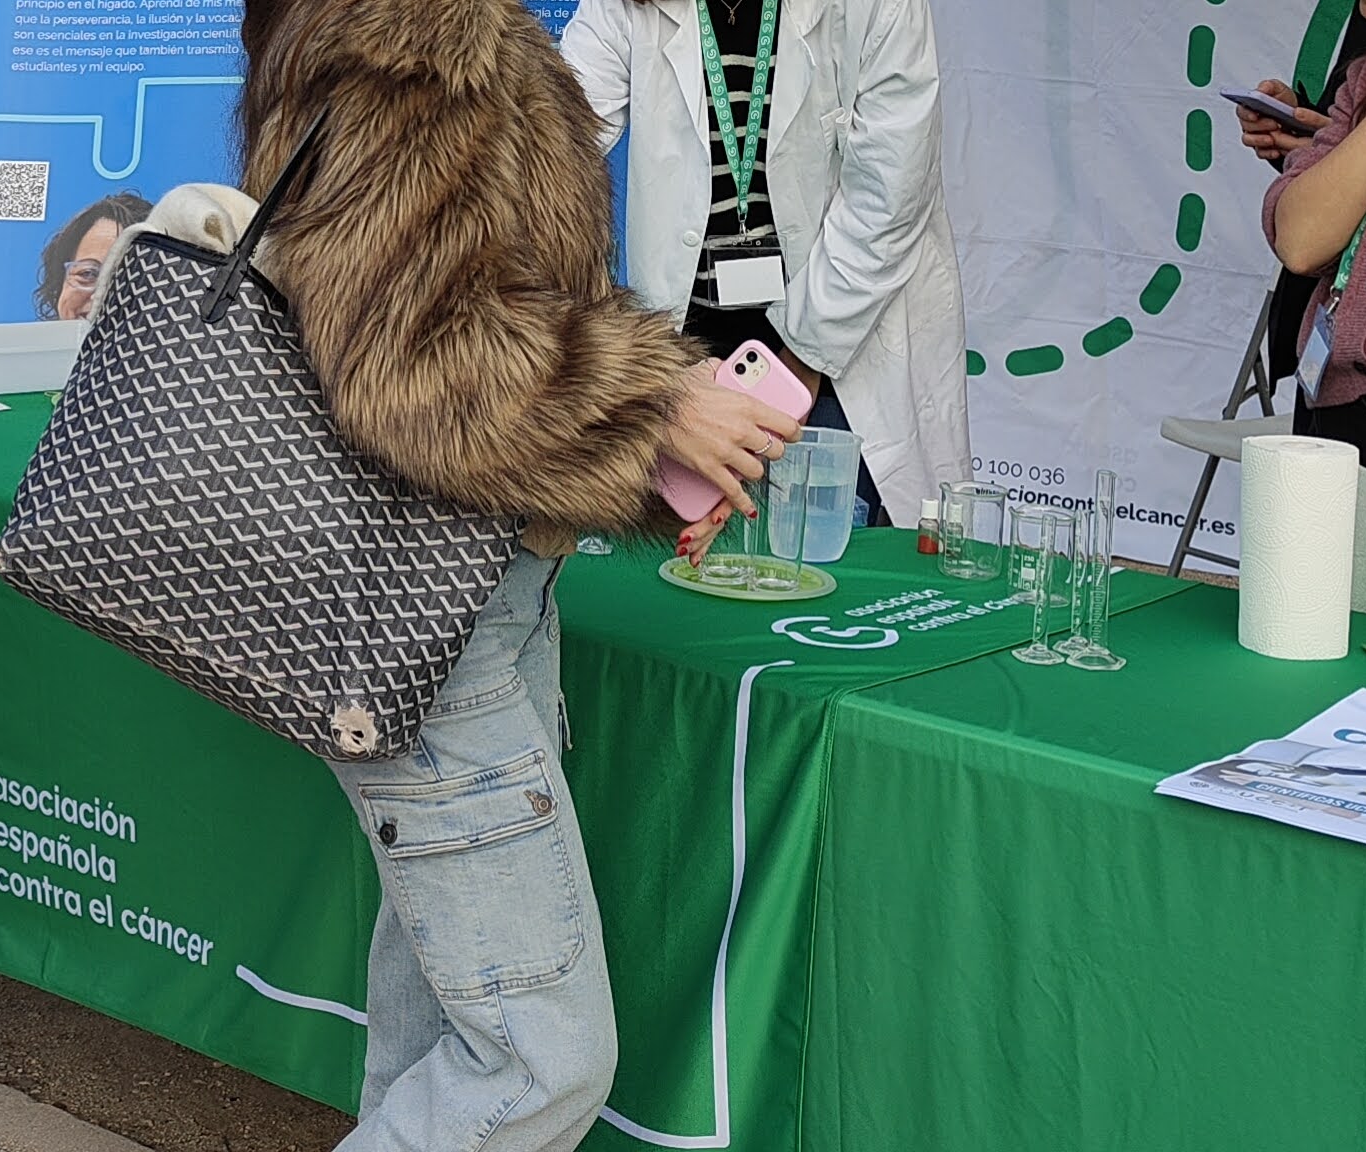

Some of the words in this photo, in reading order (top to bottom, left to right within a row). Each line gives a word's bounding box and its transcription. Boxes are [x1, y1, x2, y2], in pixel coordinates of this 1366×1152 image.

[11, 62, 77, 72] estudiantes
[79, 64, 86, 74] y
[89, 62, 103, 72] mi
[106, 62, 146, 73] equipo.
[989, 460, 1023, 478] 100
[1029, 466, 1065, 485] 036
[844, 587, 944, 617] asociación
[88, 889, 114, 928] el
[119, 903, 215, 968] cáncer
